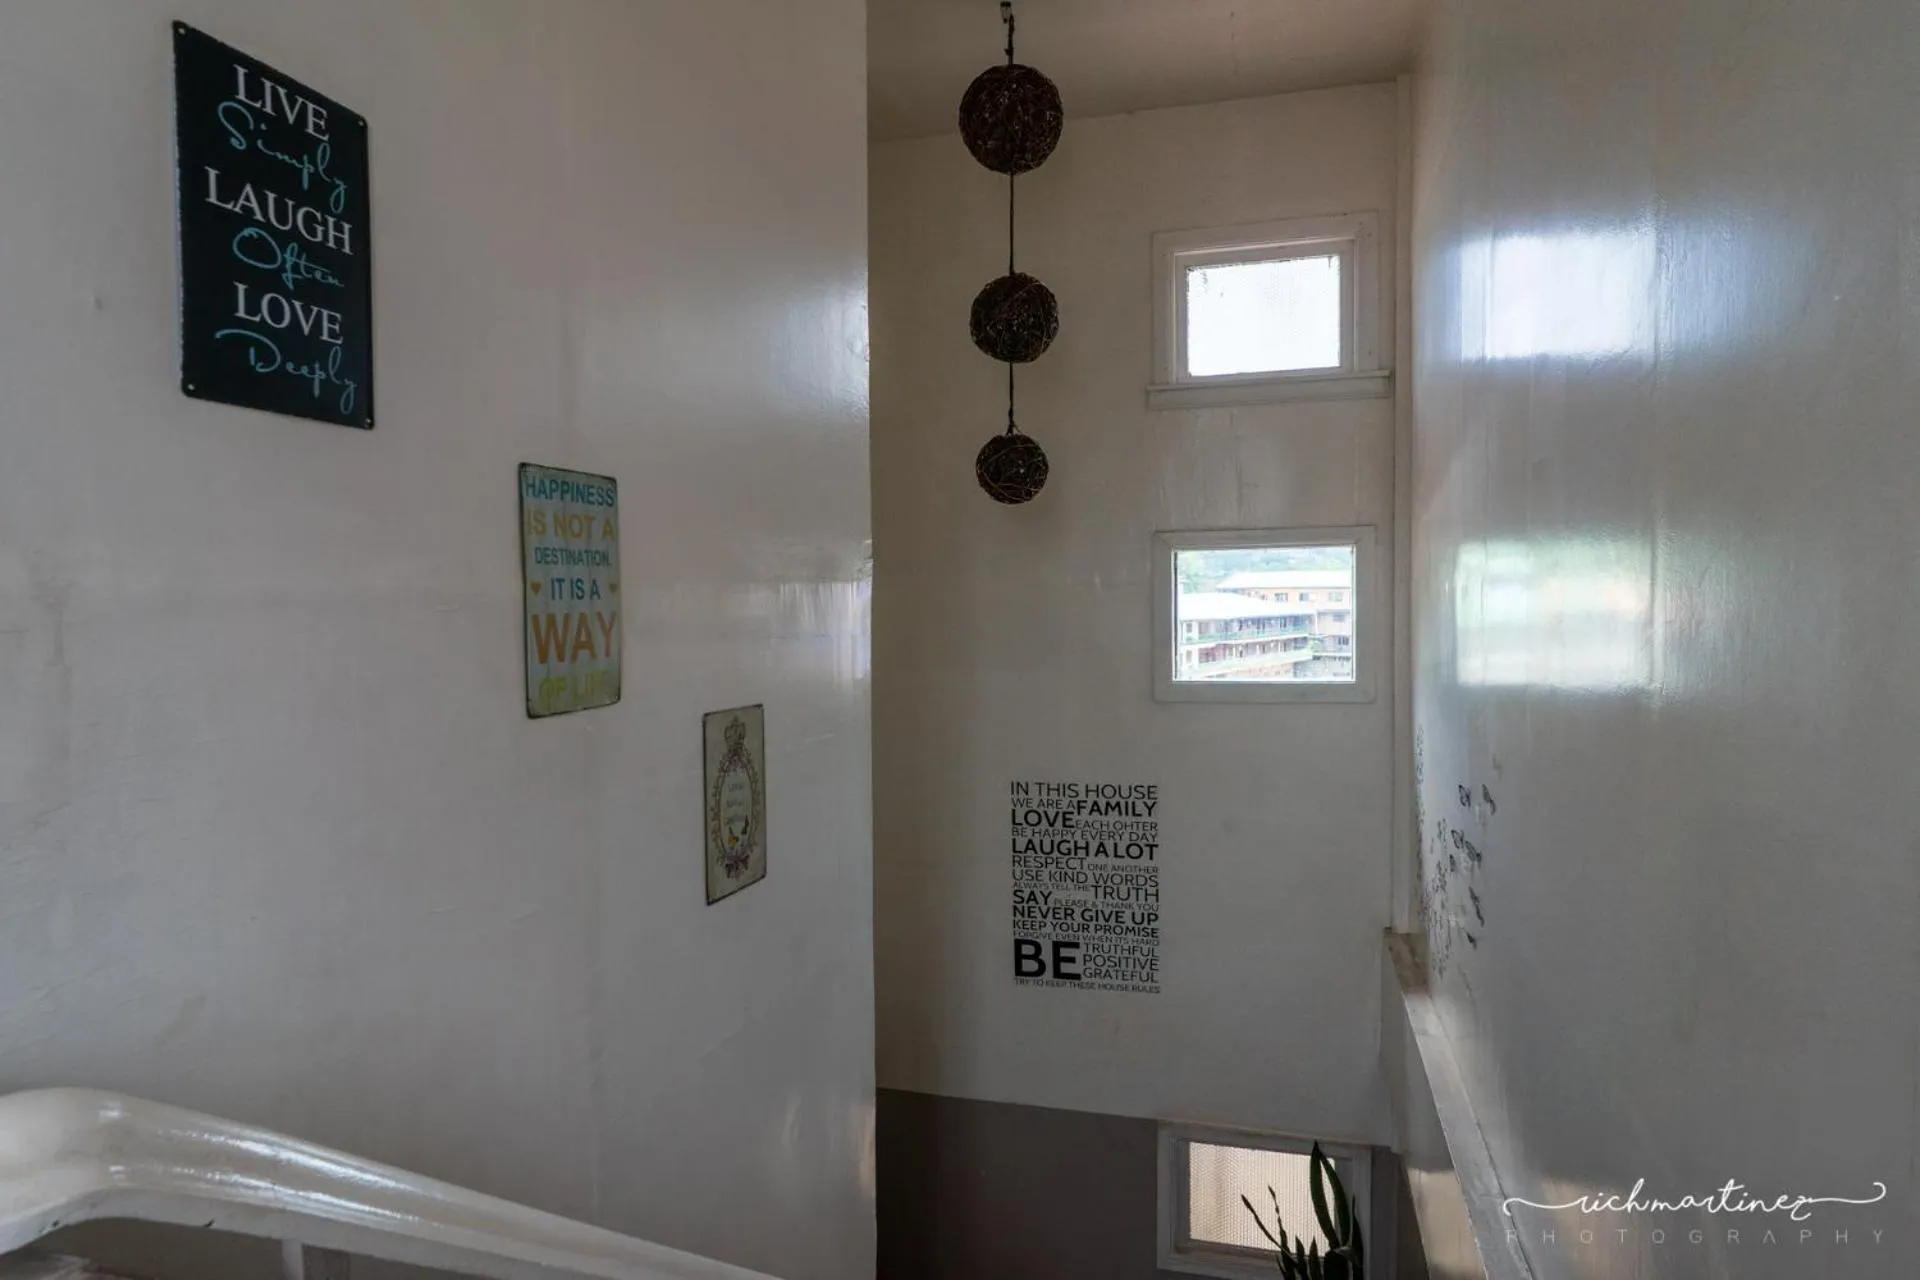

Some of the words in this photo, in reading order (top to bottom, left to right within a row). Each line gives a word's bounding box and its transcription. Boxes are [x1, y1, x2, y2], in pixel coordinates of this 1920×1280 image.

[233, 64, 329, 142] LIVE
[218, 101, 347, 214] Simply
[205, 166, 354, 255] LAUGH
[233, 228, 344, 290] Often
[233, 281, 344, 344] LOVE
[215, 329, 357, 414] Deeply
[526, 476, 615, 507] HAPPINESS
[528, 510, 546, 537] IS
[553, 513, 596, 538] NOT
[603, 516, 615, 540] A
[550, 578, 565, 600] IT
[571, 579, 585, 600] IS
[590, 580, 601, 600] A
[532, 611, 617, 664] WAY
[1011, 781, 1029, 796] IN
[1035, 782, 1080, 798] THIS
[1085, 784, 1158, 800] HOUSE
[1012, 798, 1033, 809] WE
[1037, 799, 1063, 810] ARE
[1067, 800, 1076, 810] A
[1077, 800, 1157, 817] FAMILY
[1011, 809, 1075, 828] LOVE
[1076, 819, 1109, 831] EACH
[1113, 820, 1158, 832] OHTER
[1012, 827, 1028, 838] BE
[1032, 828, 1077, 840] HAPPY
[1081, 830, 1126, 841] EVERY
[1129, 832, 1158, 843] DAY
[1012, 838, 1089, 857] LAUGH
[1012, 855, 1087, 870] RESPECT
[1087, 863, 1108, 873] ONE
[1111, 864, 1158, 874] ANOTHER
[1012, 869, 1044, 882] USE
[1050, 871, 1088, 884] KIND
[1093, 872, 1159, 888] WORDS
[1013, 882, 1049, 890] ALWAYS
[1074, 884, 1091, 892] THE
[1091, 885, 1159, 902] TRUTH
[1013, 890, 1052, 906] SAY
[1054, 898, 1087, 909] PLEASE
[1100, 901, 1134, 911] THANK
[1137, 903, 1159, 912] YOU
[1013, 906, 1075, 920] NEVER
[1081, 909, 1126, 924] GIVE
[1132, 912, 1159, 926] UP
[1013, 920, 1047, 931] KEEP
[1050, 922, 1090, 933] YOUR
[1094, 924, 1159, 938] PROMISE
[1013, 931, 1052, 941] FORGIVE
[1056, 933, 1080, 942] EVEN
[1082, 934, 1112, 944] WHEN
[1131, 937, 1159, 946] HARD
[1014, 939, 1081, 981] BE
[1084, 943, 1159, 958] TRUTHFUL
[1083, 954, 1159, 971] POSITIVE
[1083, 967, 1159, 983] GRATEFUL
